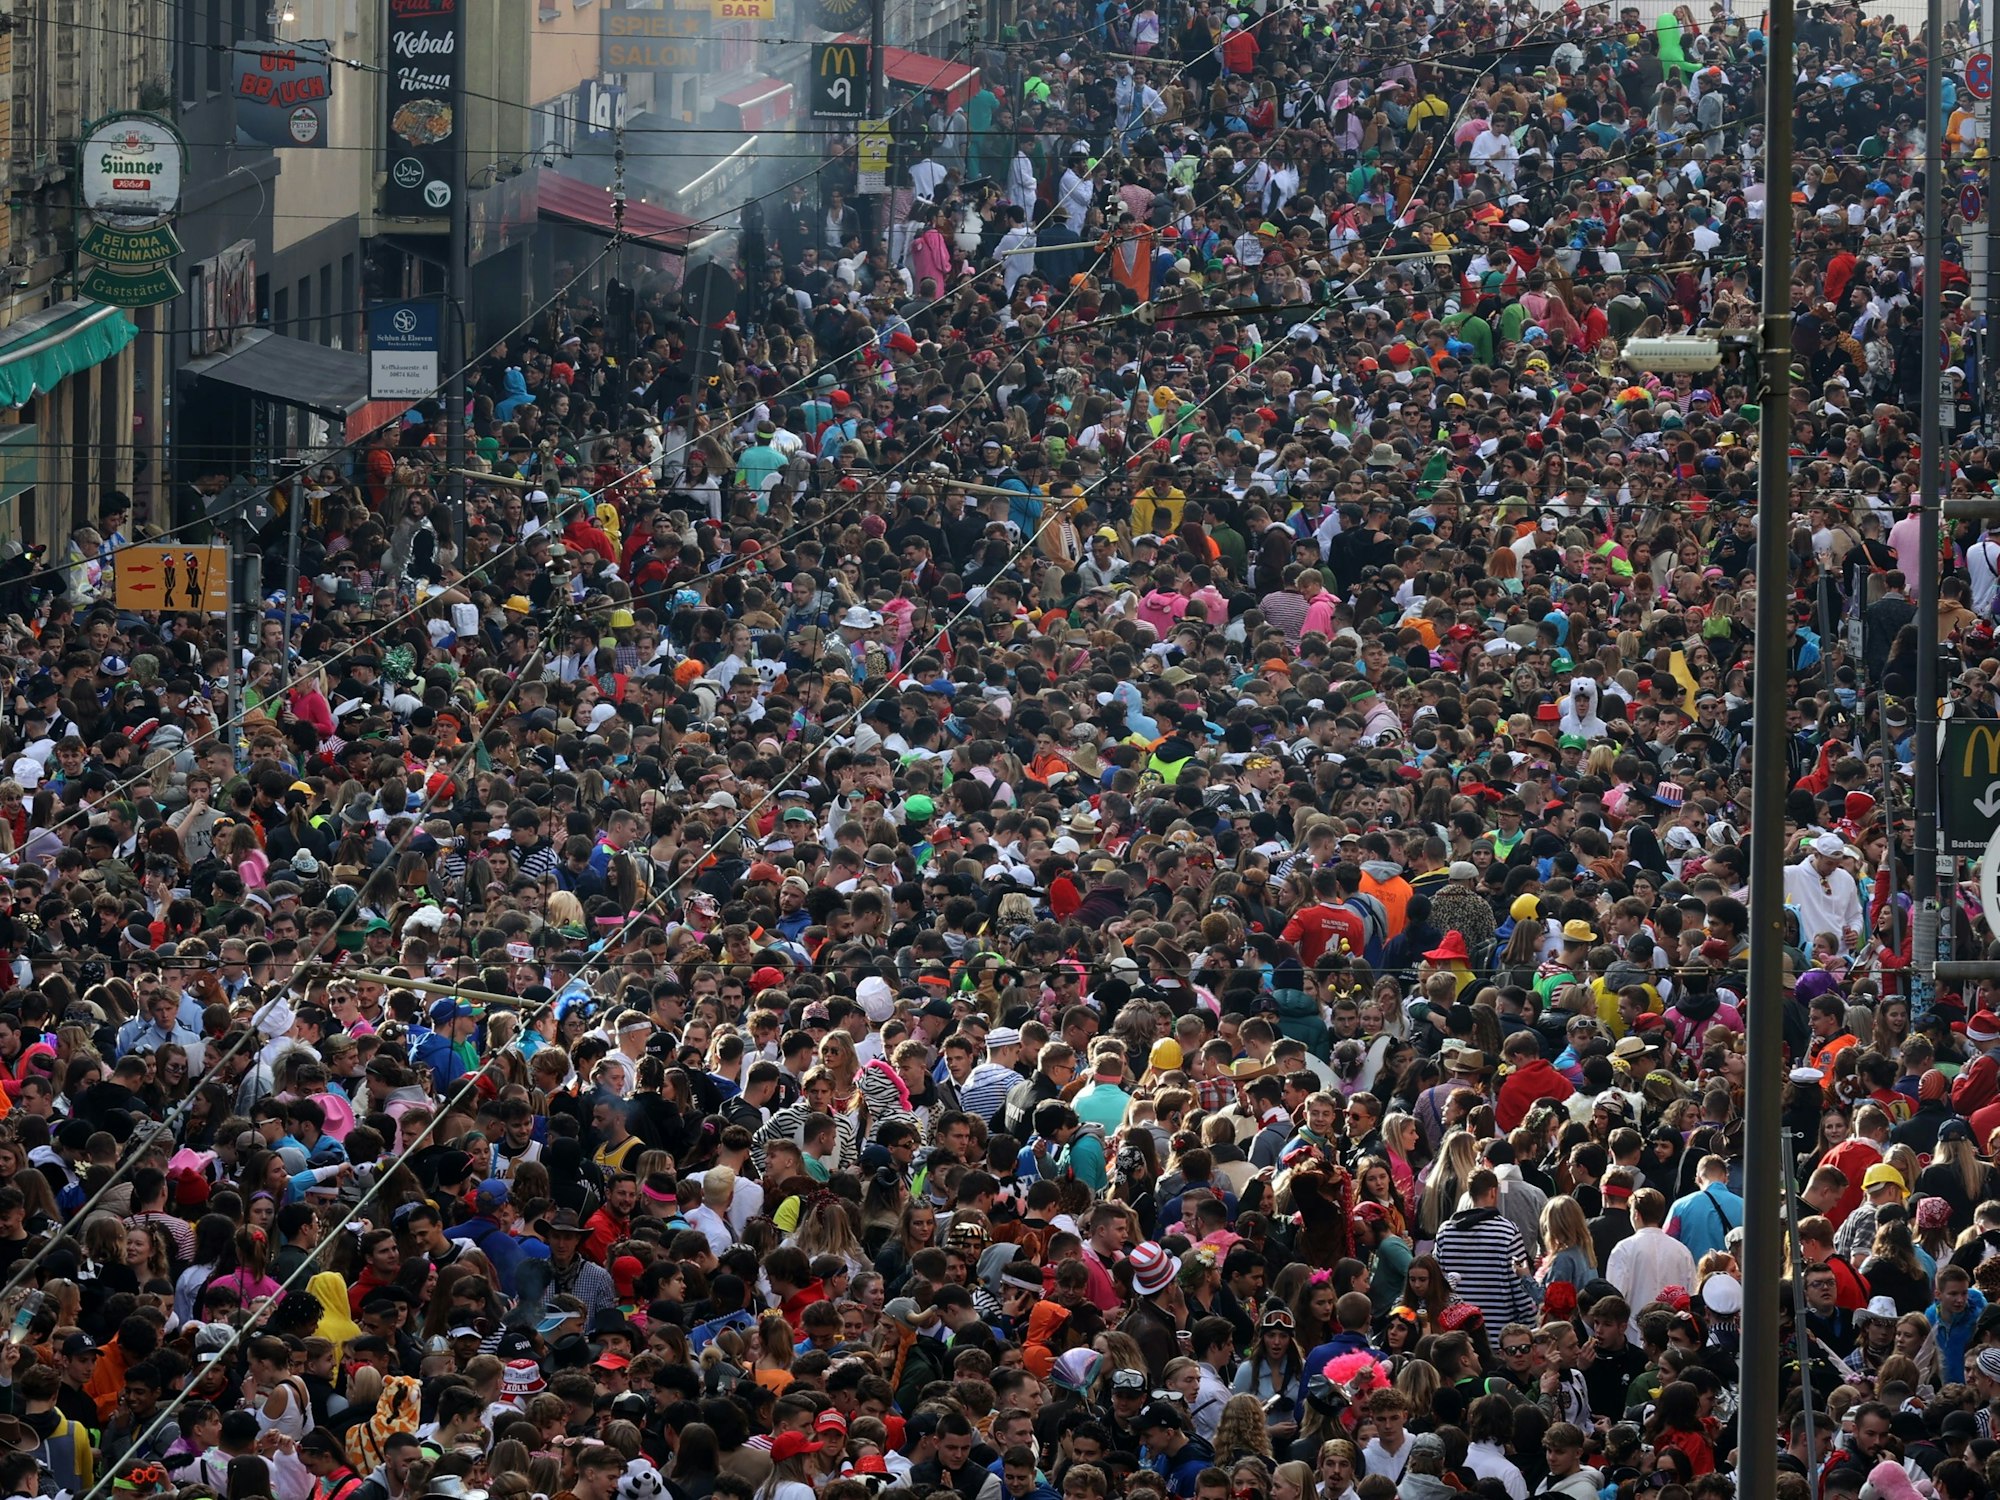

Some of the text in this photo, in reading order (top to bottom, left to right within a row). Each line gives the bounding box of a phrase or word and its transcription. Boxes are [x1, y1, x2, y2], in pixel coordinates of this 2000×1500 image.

[722, 4, 760, 17] BAR
[610, 16, 679, 36] SPIEL
[393, 30, 454, 58] Kebab
[609, 44, 697, 66] SALON
[397, 67, 450, 91] Haus
[240, 73, 325, 107] BRAUCH
[291, 121, 316, 129] PETERS
[100, 154, 163, 175] Sünner
[117, 180, 144, 189] Kölsch
[102, 234, 160, 249] BEI OMA
[91, 242, 170, 261] KLEINMANN
[92, 279, 167, 297] Gaststätte
